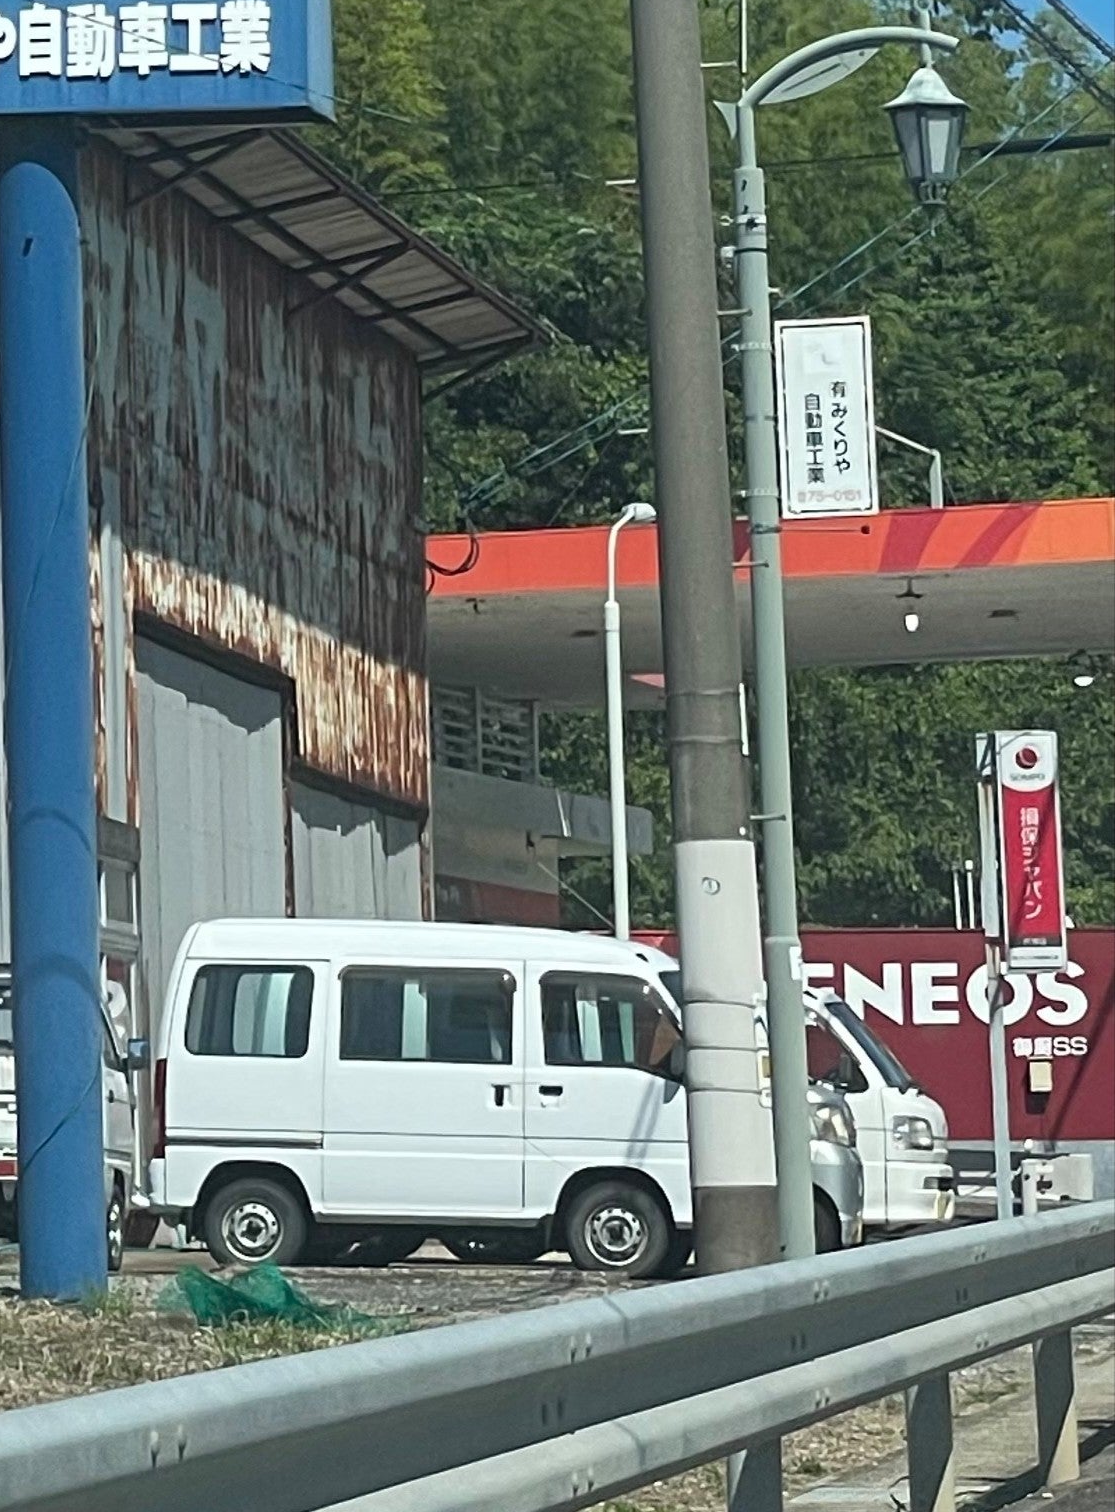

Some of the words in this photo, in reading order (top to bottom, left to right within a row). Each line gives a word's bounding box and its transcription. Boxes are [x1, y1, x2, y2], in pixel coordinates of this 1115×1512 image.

[804, 393, 826, 484] 自動車工業
